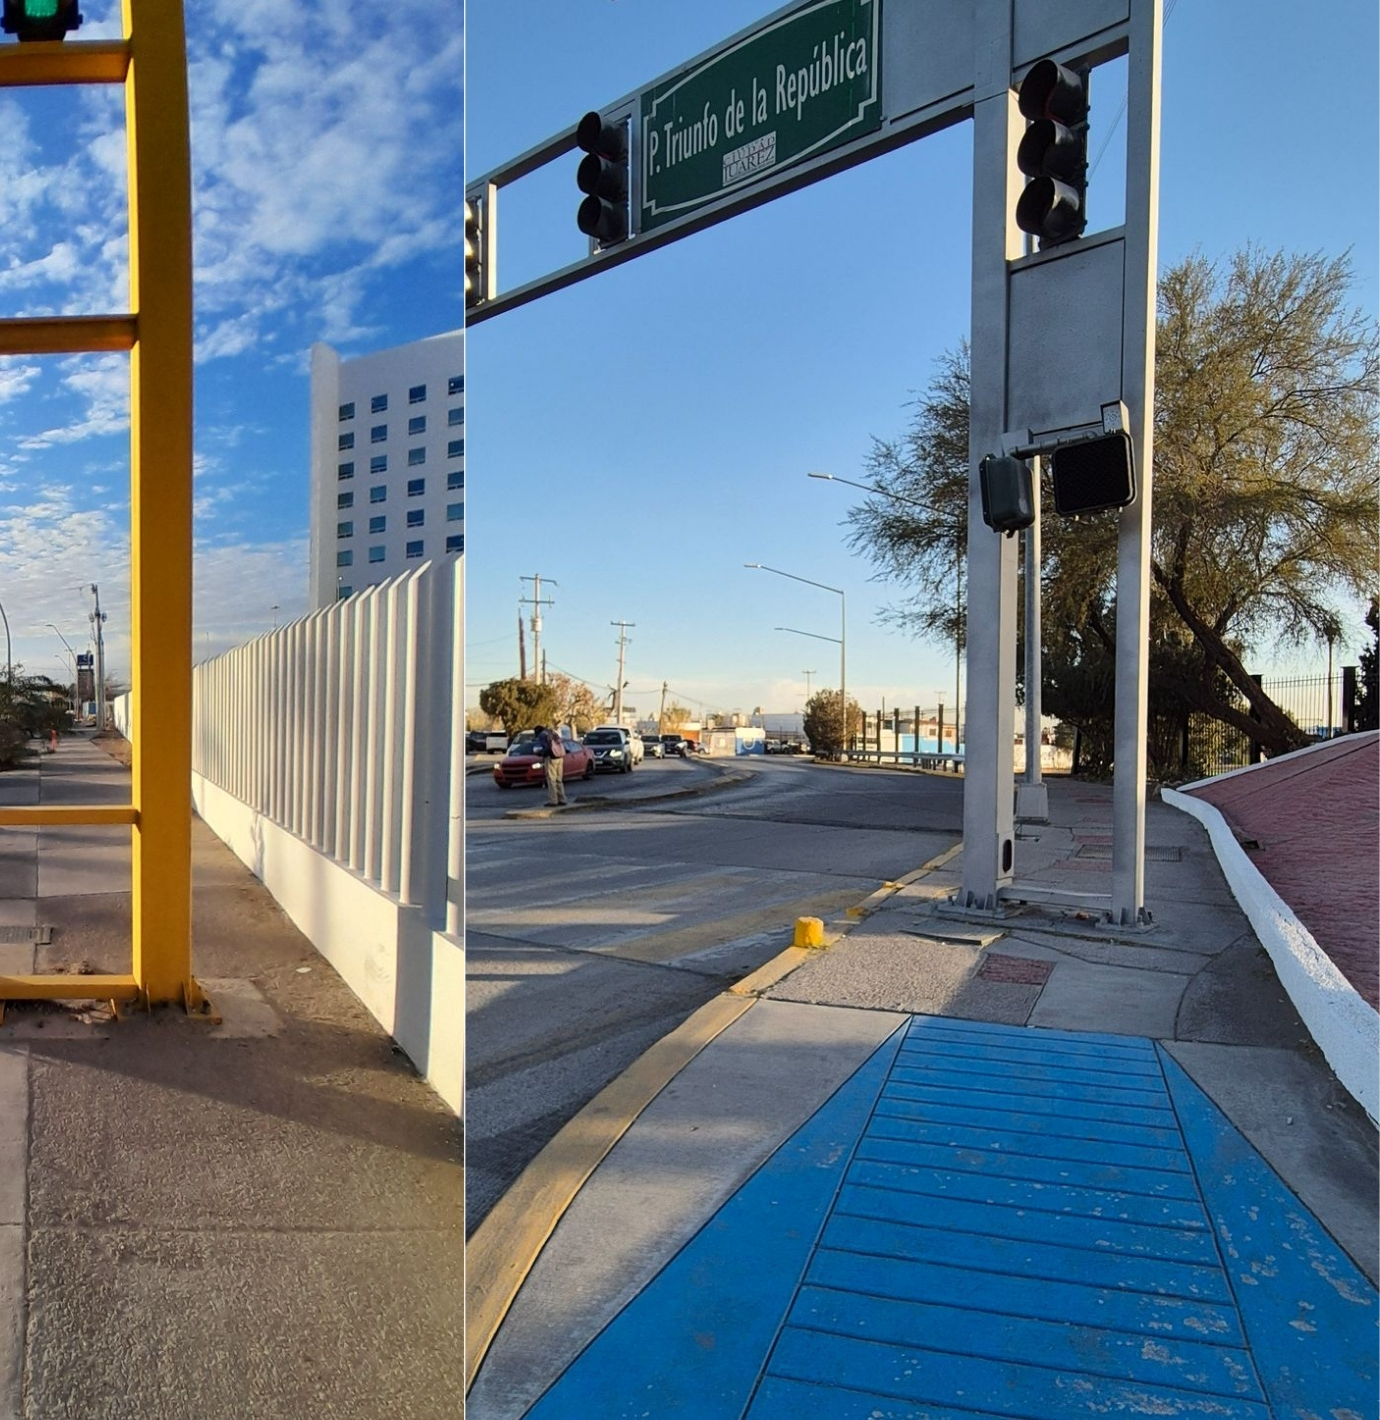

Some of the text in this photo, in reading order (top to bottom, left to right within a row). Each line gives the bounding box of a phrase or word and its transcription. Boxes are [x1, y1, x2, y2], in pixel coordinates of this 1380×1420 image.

[649, 31, 868, 176] P. Triunfo de la República
